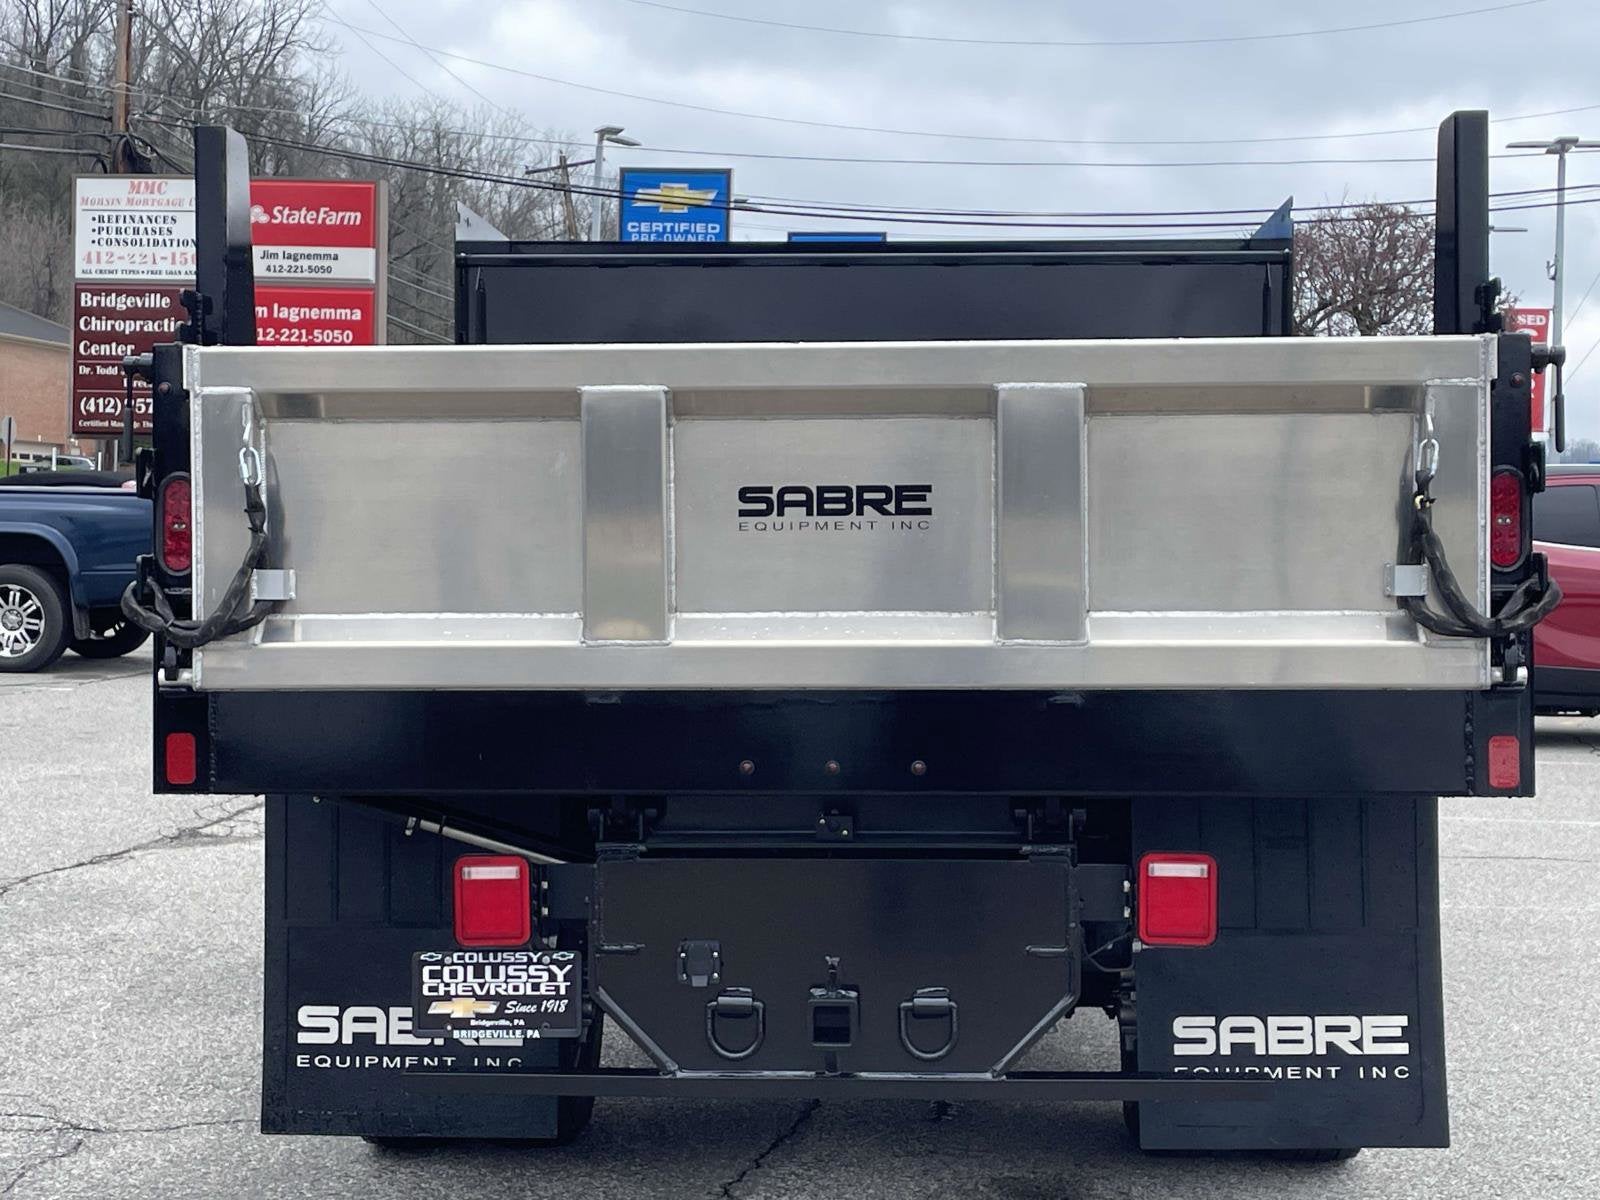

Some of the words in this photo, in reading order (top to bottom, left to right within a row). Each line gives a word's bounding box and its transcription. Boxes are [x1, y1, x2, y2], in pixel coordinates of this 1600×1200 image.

[128, 180, 168, 195] MMC
[97, 214, 177, 225] REFINANCES
[97, 226, 173, 236] PURCHASES
[627, 222, 720, 233] CERTIFIED
[631, 233, 716, 242] PRE-OWNED
[260, 250, 279, 260] Jim
[282, 251, 339, 262] Iagnemma
[266, 264, 333, 274] 412-221-5050
[80, 292, 171, 311] Bridgeville
[273, 303, 362, 322] Iagnemma
[79, 316, 182, 335] Chiropracti
[256, 328, 353, 343] 12-221-5050
[79, 340, 135, 356] Center
[79, 365, 94, 375] Dr.
[95, 365, 118, 375] Todd
[738, 484, 933, 517] SABRE
[738, 521, 878, 531] EQUIPMENT
[891, 520, 930, 531] INC
[453, 951, 542, 964] COLUSSY
[422, 964, 573, 983] COLUSSY
[422, 982, 571, 996] CHEVROLET
[504, 999, 537, 1014] Since
[540, 999, 569, 1013] 1918
[527, 1029, 540, 1039] PA
[1173, 1015, 1409, 1055] SABRE
[1359, 1066, 1410, 1079] INC
